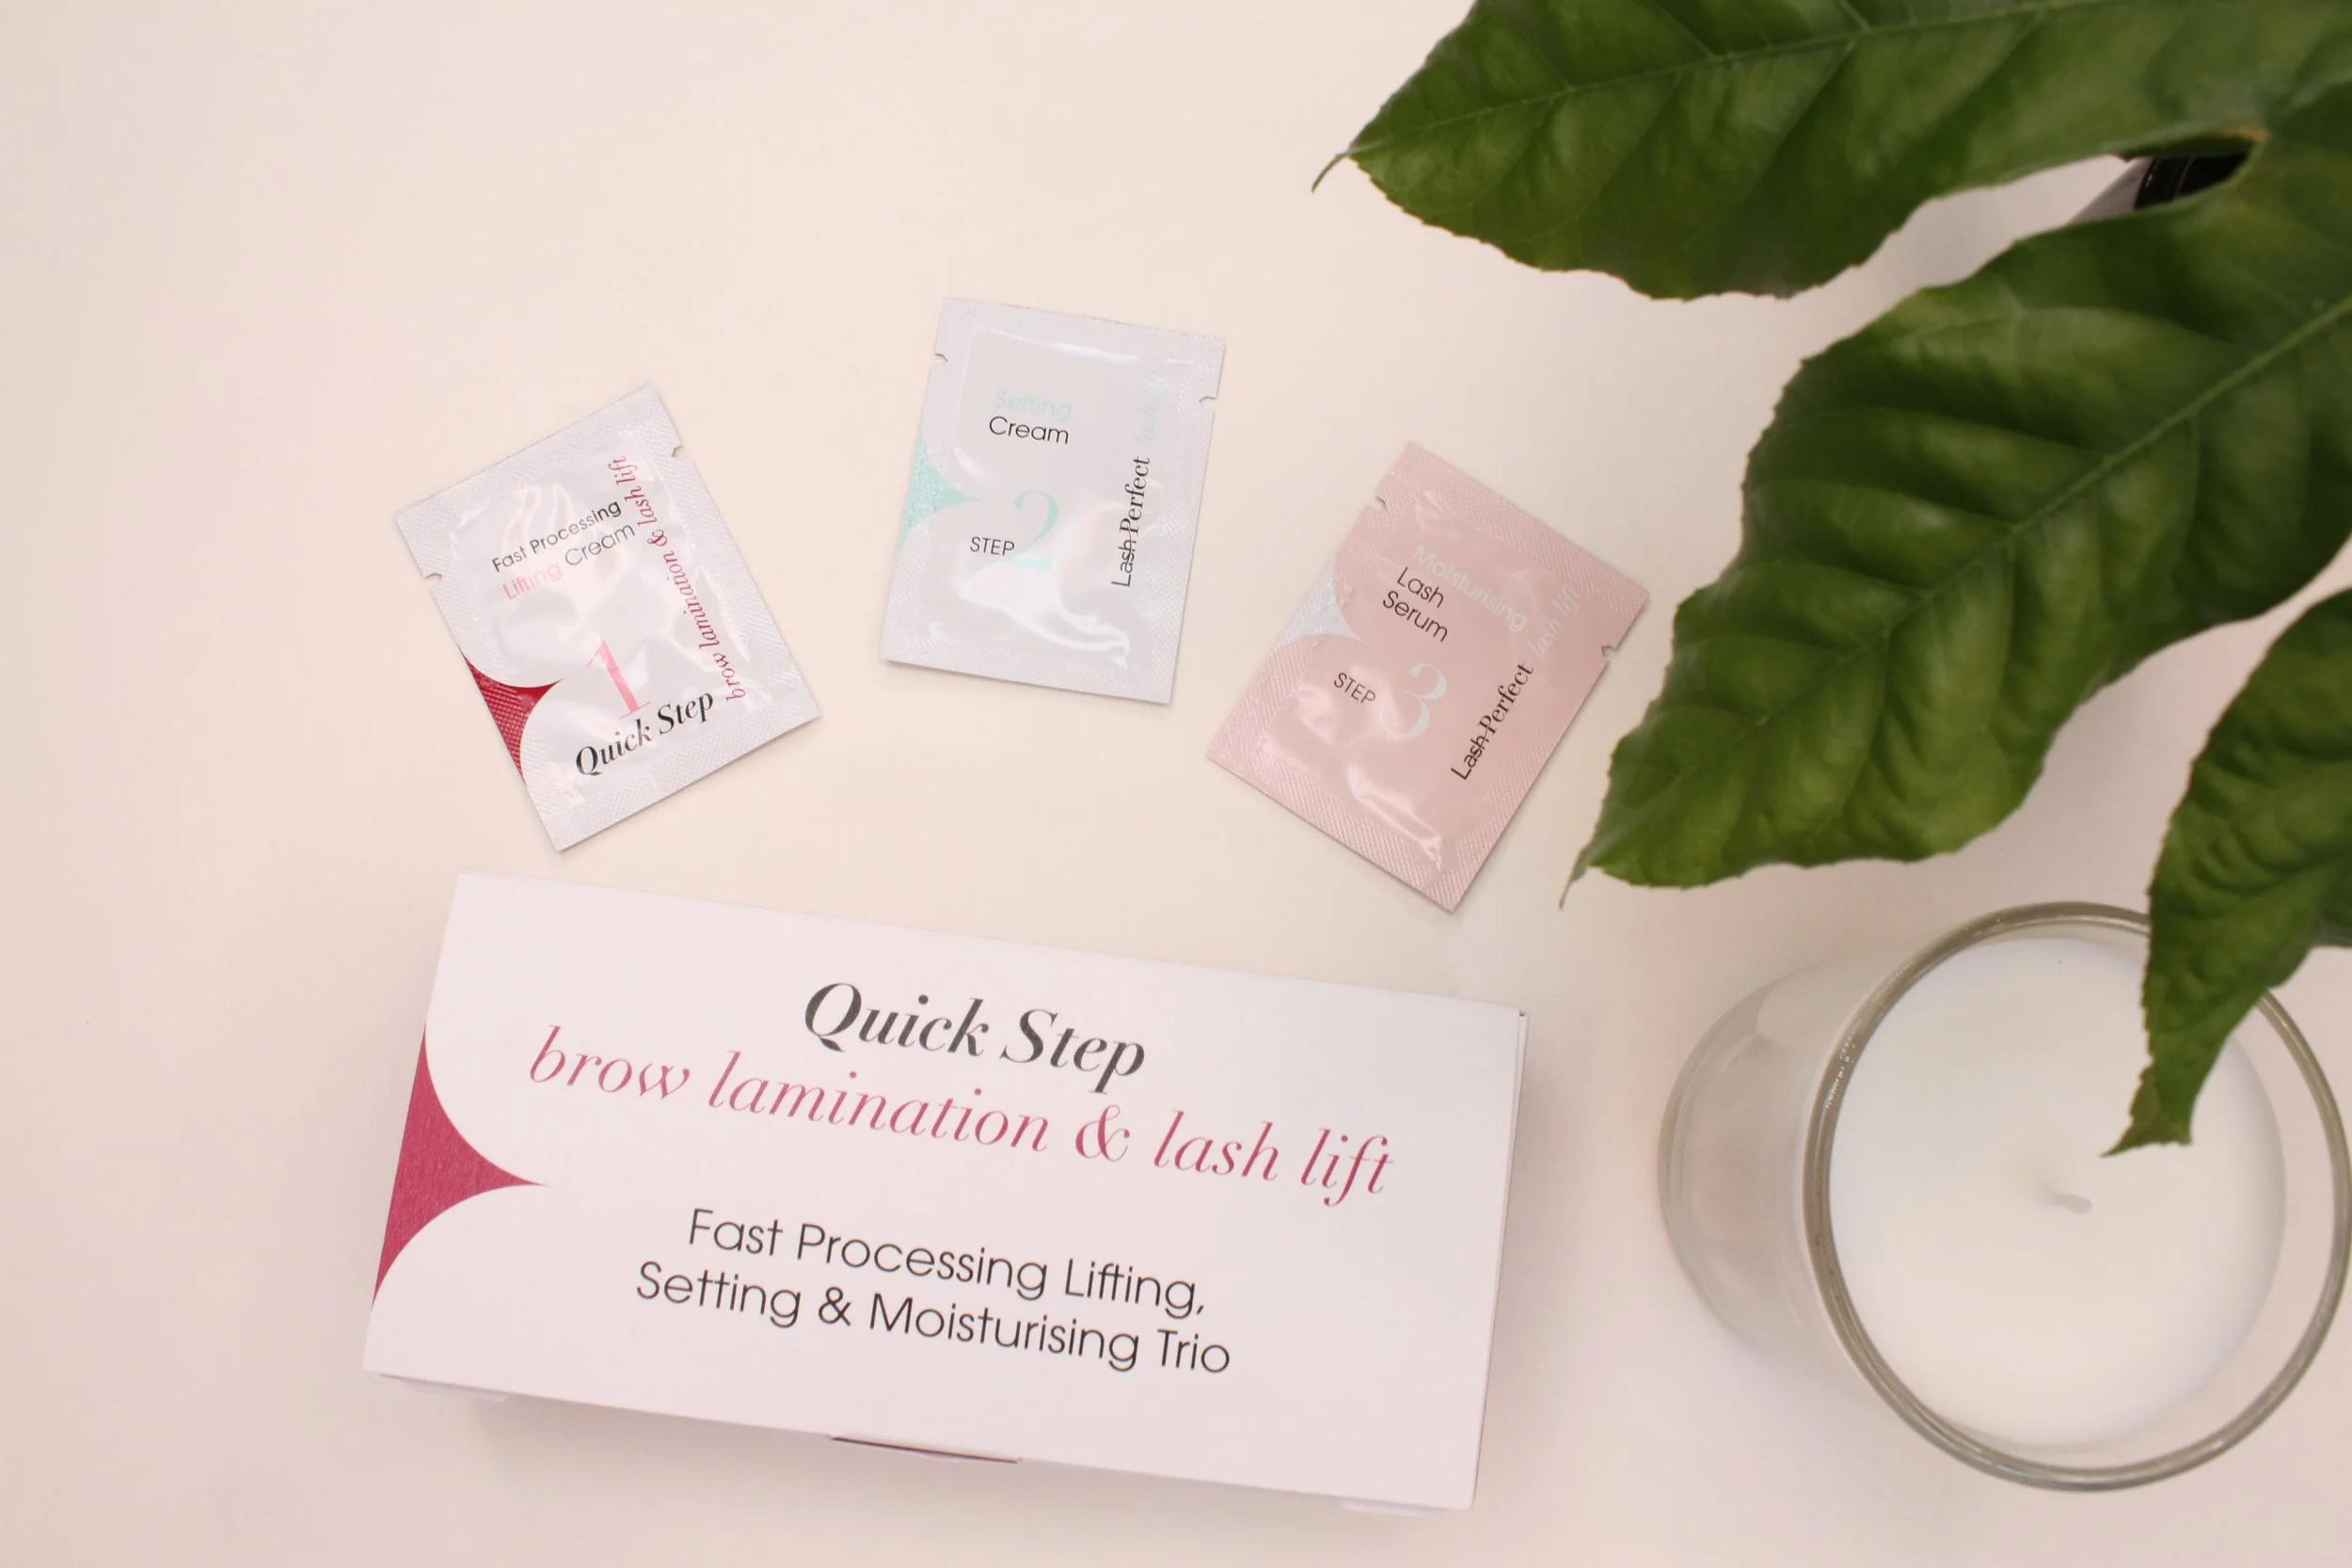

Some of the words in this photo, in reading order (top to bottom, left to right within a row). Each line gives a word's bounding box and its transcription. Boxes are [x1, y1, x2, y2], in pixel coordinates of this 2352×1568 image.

[989, 416, 1070, 445] Cream
[994, 388, 1073, 422] Setting
[607, 455, 637, 486] lift
[624, 485, 659, 528] lash
[1119, 455, 1151, 536] Perfect
[491, 545, 529, 574] Fast
[530, 499, 622, 555] Processing
[502, 561, 564, 601] Lifting
[564, 522, 636, 566] Cream
[646, 529, 669, 548] &
[969, 536, 1016, 557] STEP
[1000, 490, 1059, 568] 2
[1111, 539, 1137, 588] Lash
[661, 549, 721, 650] lamination
[1383, 591, 1449, 642] Serum
[1396, 566, 1445, 609] Lash
[1413, 545, 1528, 633] Moisturising
[586, 639, 651, 720] 1
[712, 651, 747, 702] brow
[1334, 672, 1376, 705] STEP
[1379, 662, 1448, 741] 3
[1450, 730, 1490, 781] Lash
[1478, 660, 1534, 736] Perfect
[1528, 616, 1562, 659] lash
[575, 719, 654, 777] Quick
[658, 692, 714, 736] Step
[804, 982, 990, 1054] Quick
[1000, 1008, 1146, 1094] Step
[529, 1024, 691, 1100] brow
[707, 1050, 1050, 1153] lamination
[1074, 1104, 1131, 1162] &
[1152, 1110, 1279, 1181] lash
[1299, 1128, 1394, 1207] lift
[688, 1208, 785, 1256] Fast
[797, 1223, 1047, 1300] Processing
[1064, 1259, 1205, 1318] Lifting,
[636, 1261, 802, 1327] Setting
[818, 1287, 852, 1326] &
[868, 1293, 1140, 1372] Moisturising
[1157, 1329, 1231, 1373] Trio
